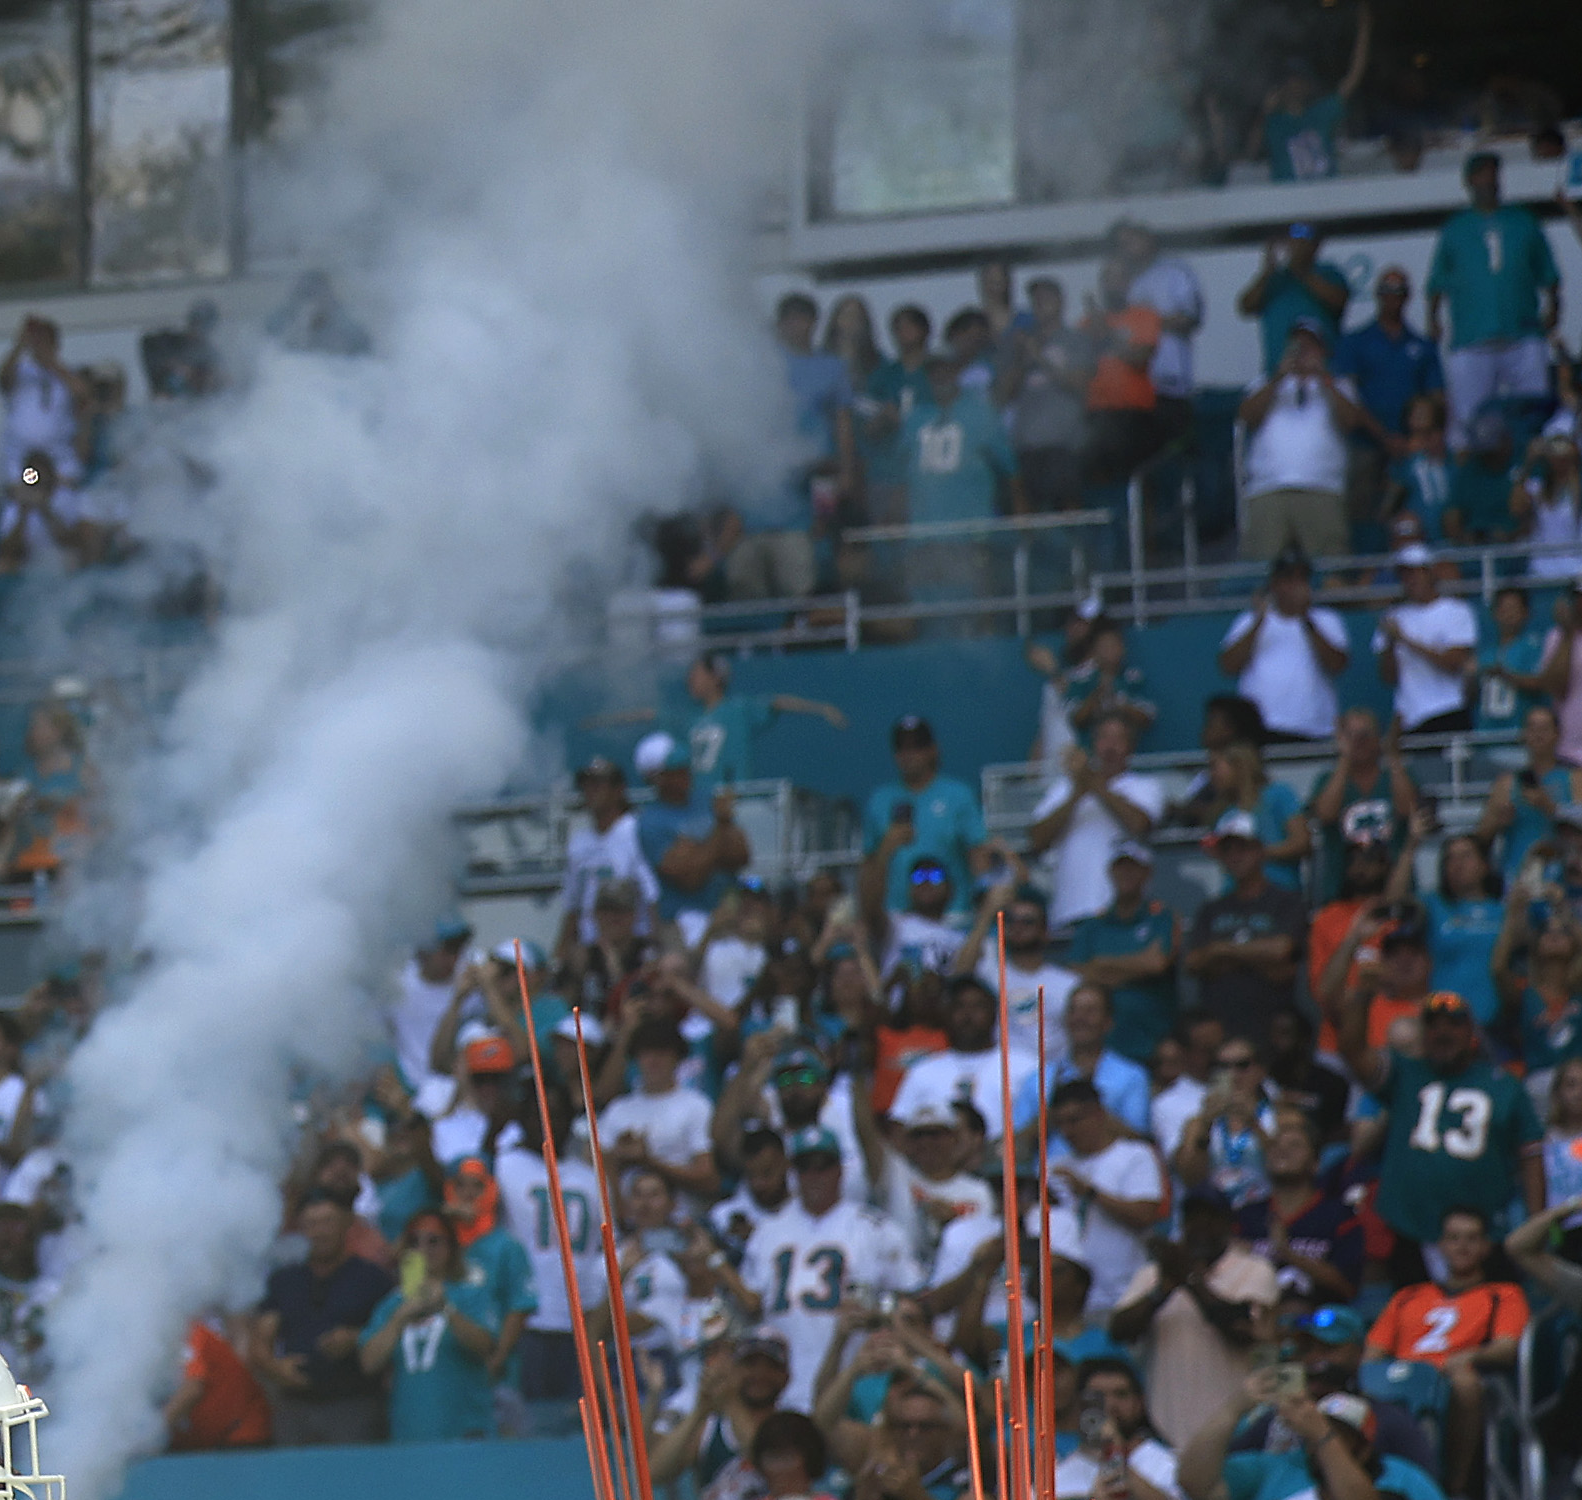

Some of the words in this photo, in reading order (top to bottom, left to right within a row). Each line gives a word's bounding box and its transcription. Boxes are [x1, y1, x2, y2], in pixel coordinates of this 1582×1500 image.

[1411, 1083, 1492, 1159] 13
[774, 1246, 844, 1311] 13
[1412, 1307, 1457, 1354] 2
